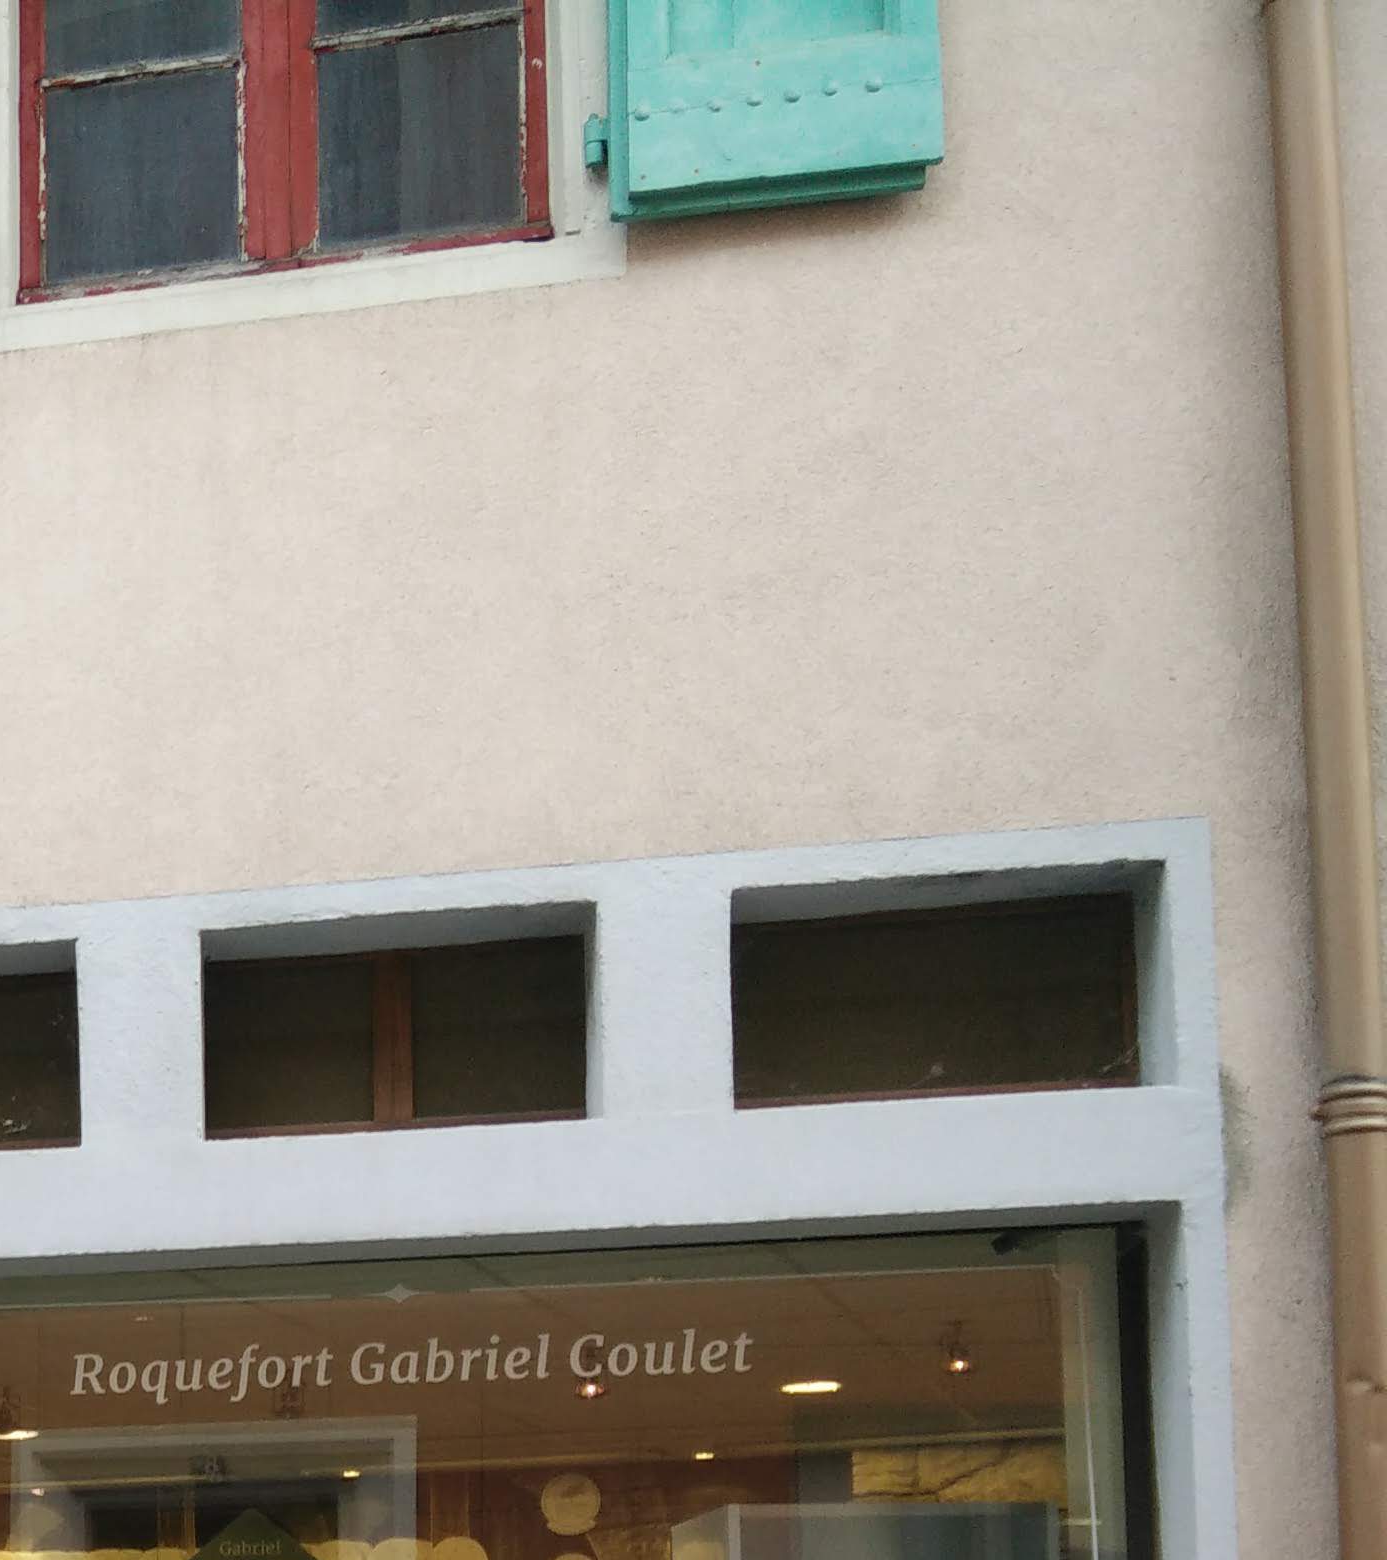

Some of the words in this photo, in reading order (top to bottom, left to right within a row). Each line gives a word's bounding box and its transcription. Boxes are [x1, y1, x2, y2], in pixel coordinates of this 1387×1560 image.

[70, 1343, 333, 1404] Roquefort
[350, 1333, 551, 1387] Gabriel
[569, 1328, 754, 1378] Coulet
[219, 1539, 283, 1556] Gabriel
